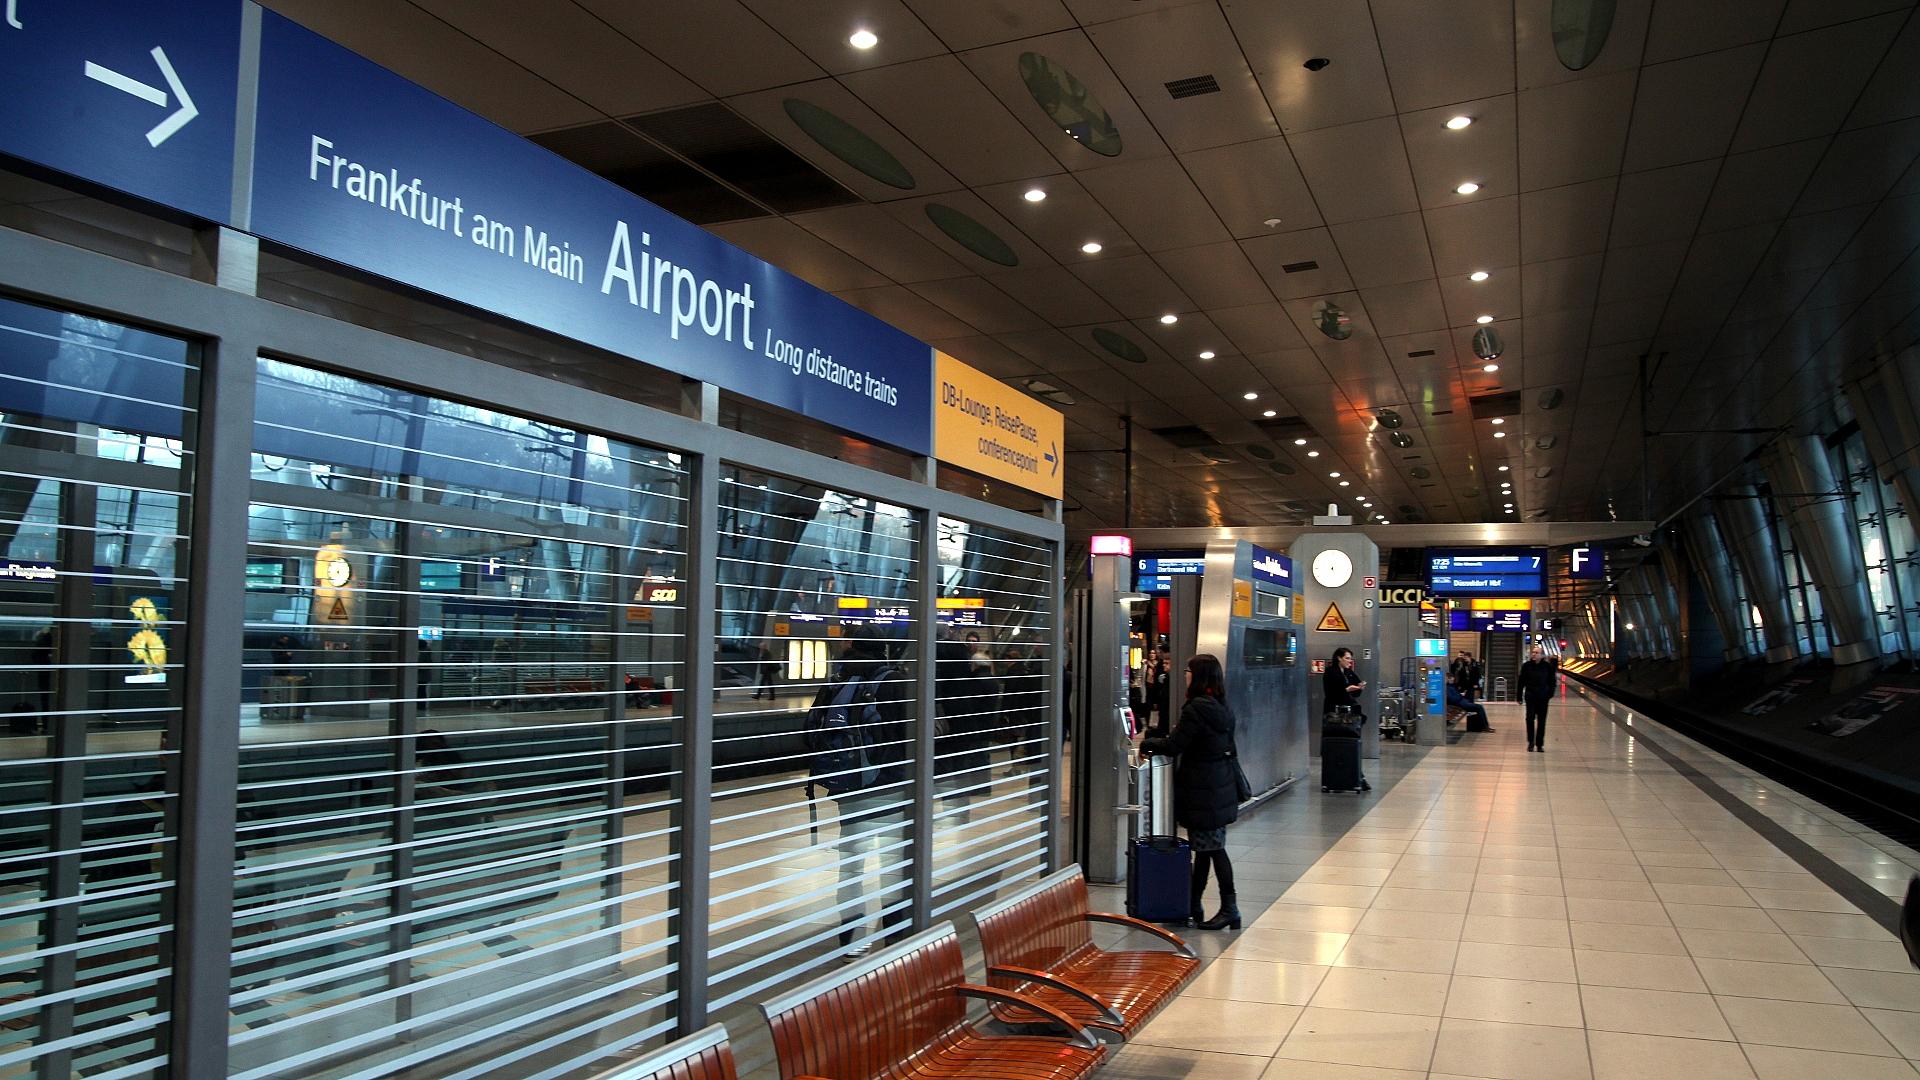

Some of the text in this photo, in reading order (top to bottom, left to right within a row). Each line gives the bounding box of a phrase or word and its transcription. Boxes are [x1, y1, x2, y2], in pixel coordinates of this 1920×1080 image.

[309, 134, 898, 407] Frankfurt am Main Airport Long distance trains
[489, 557, 501, 576] F
[1138, 559, 1147, 570] 6
[1531, 556, 1541, 569] 7
[1572, 548, 1590, 572] F
